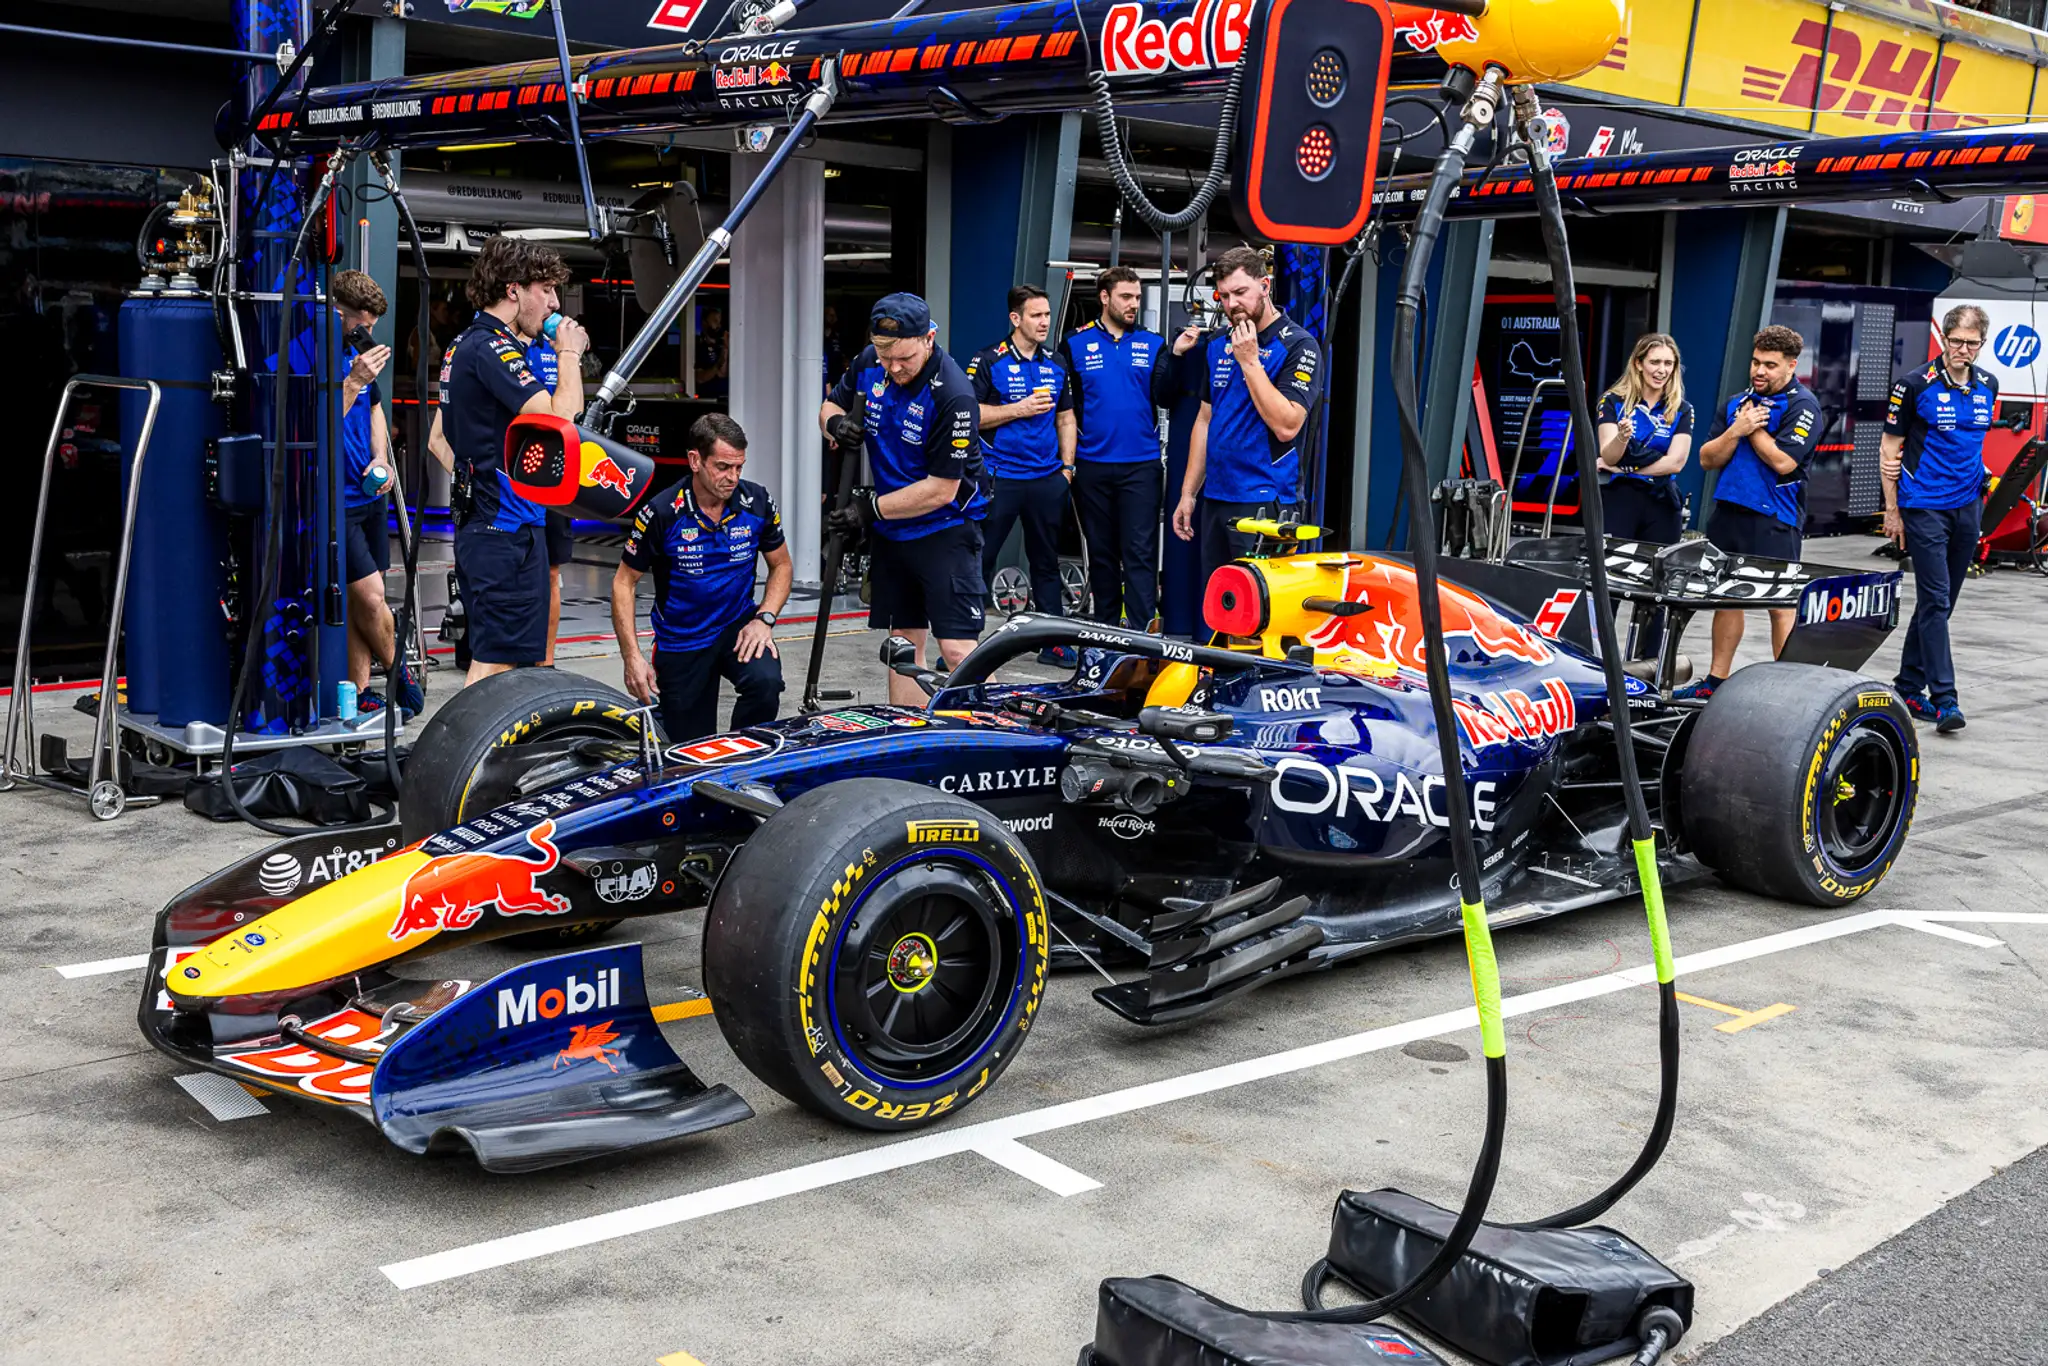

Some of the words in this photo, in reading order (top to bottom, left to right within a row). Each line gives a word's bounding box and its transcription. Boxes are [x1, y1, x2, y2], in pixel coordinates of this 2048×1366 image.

[1102, 0, 1212, 76] Red
[719, 40, 801, 64] ORACLE
[715, 70, 735, 88] Red
[736, 65, 757, 87] Bull
[1778, 18, 1961, 131] DHL
[719, 93, 801, 110] RACING
[1734, 146, 1804, 161] ORACLE
[1729, 162, 1747, 178] Red
[1747, 161, 1765, 177] Bull
[1730, 181, 1798, 192] RACING
[1891, 203, 1925, 214] RACING
[1513, 317, 1561, 330] AUSTRALIA
[1997, 324, 2038, 368] hp
[1805, 584, 1868, 625] Mobil
[1078, 630, 1132, 647] DAMAC
[1159, 642, 1193, 662] VISA
[1259, 688, 1321, 712] ROKT
[1451, 691, 1524, 748] Red
[1502, 678, 1576, 741] Bull
[940, 766, 1056, 794] CARLYLE
[1270, 758, 1497, 832] ORACE
[905, 819, 979, 843] PIRELLI
[1098, 817, 1127, 829] Hard
[1128, 817, 1156, 832] Rock
[308, 847, 384, 884] AT&T
[1820, 871, 1876, 899] ZERO
[497, 967, 620, 1029] Mobil
[843, 1088, 954, 1121] ZERO
